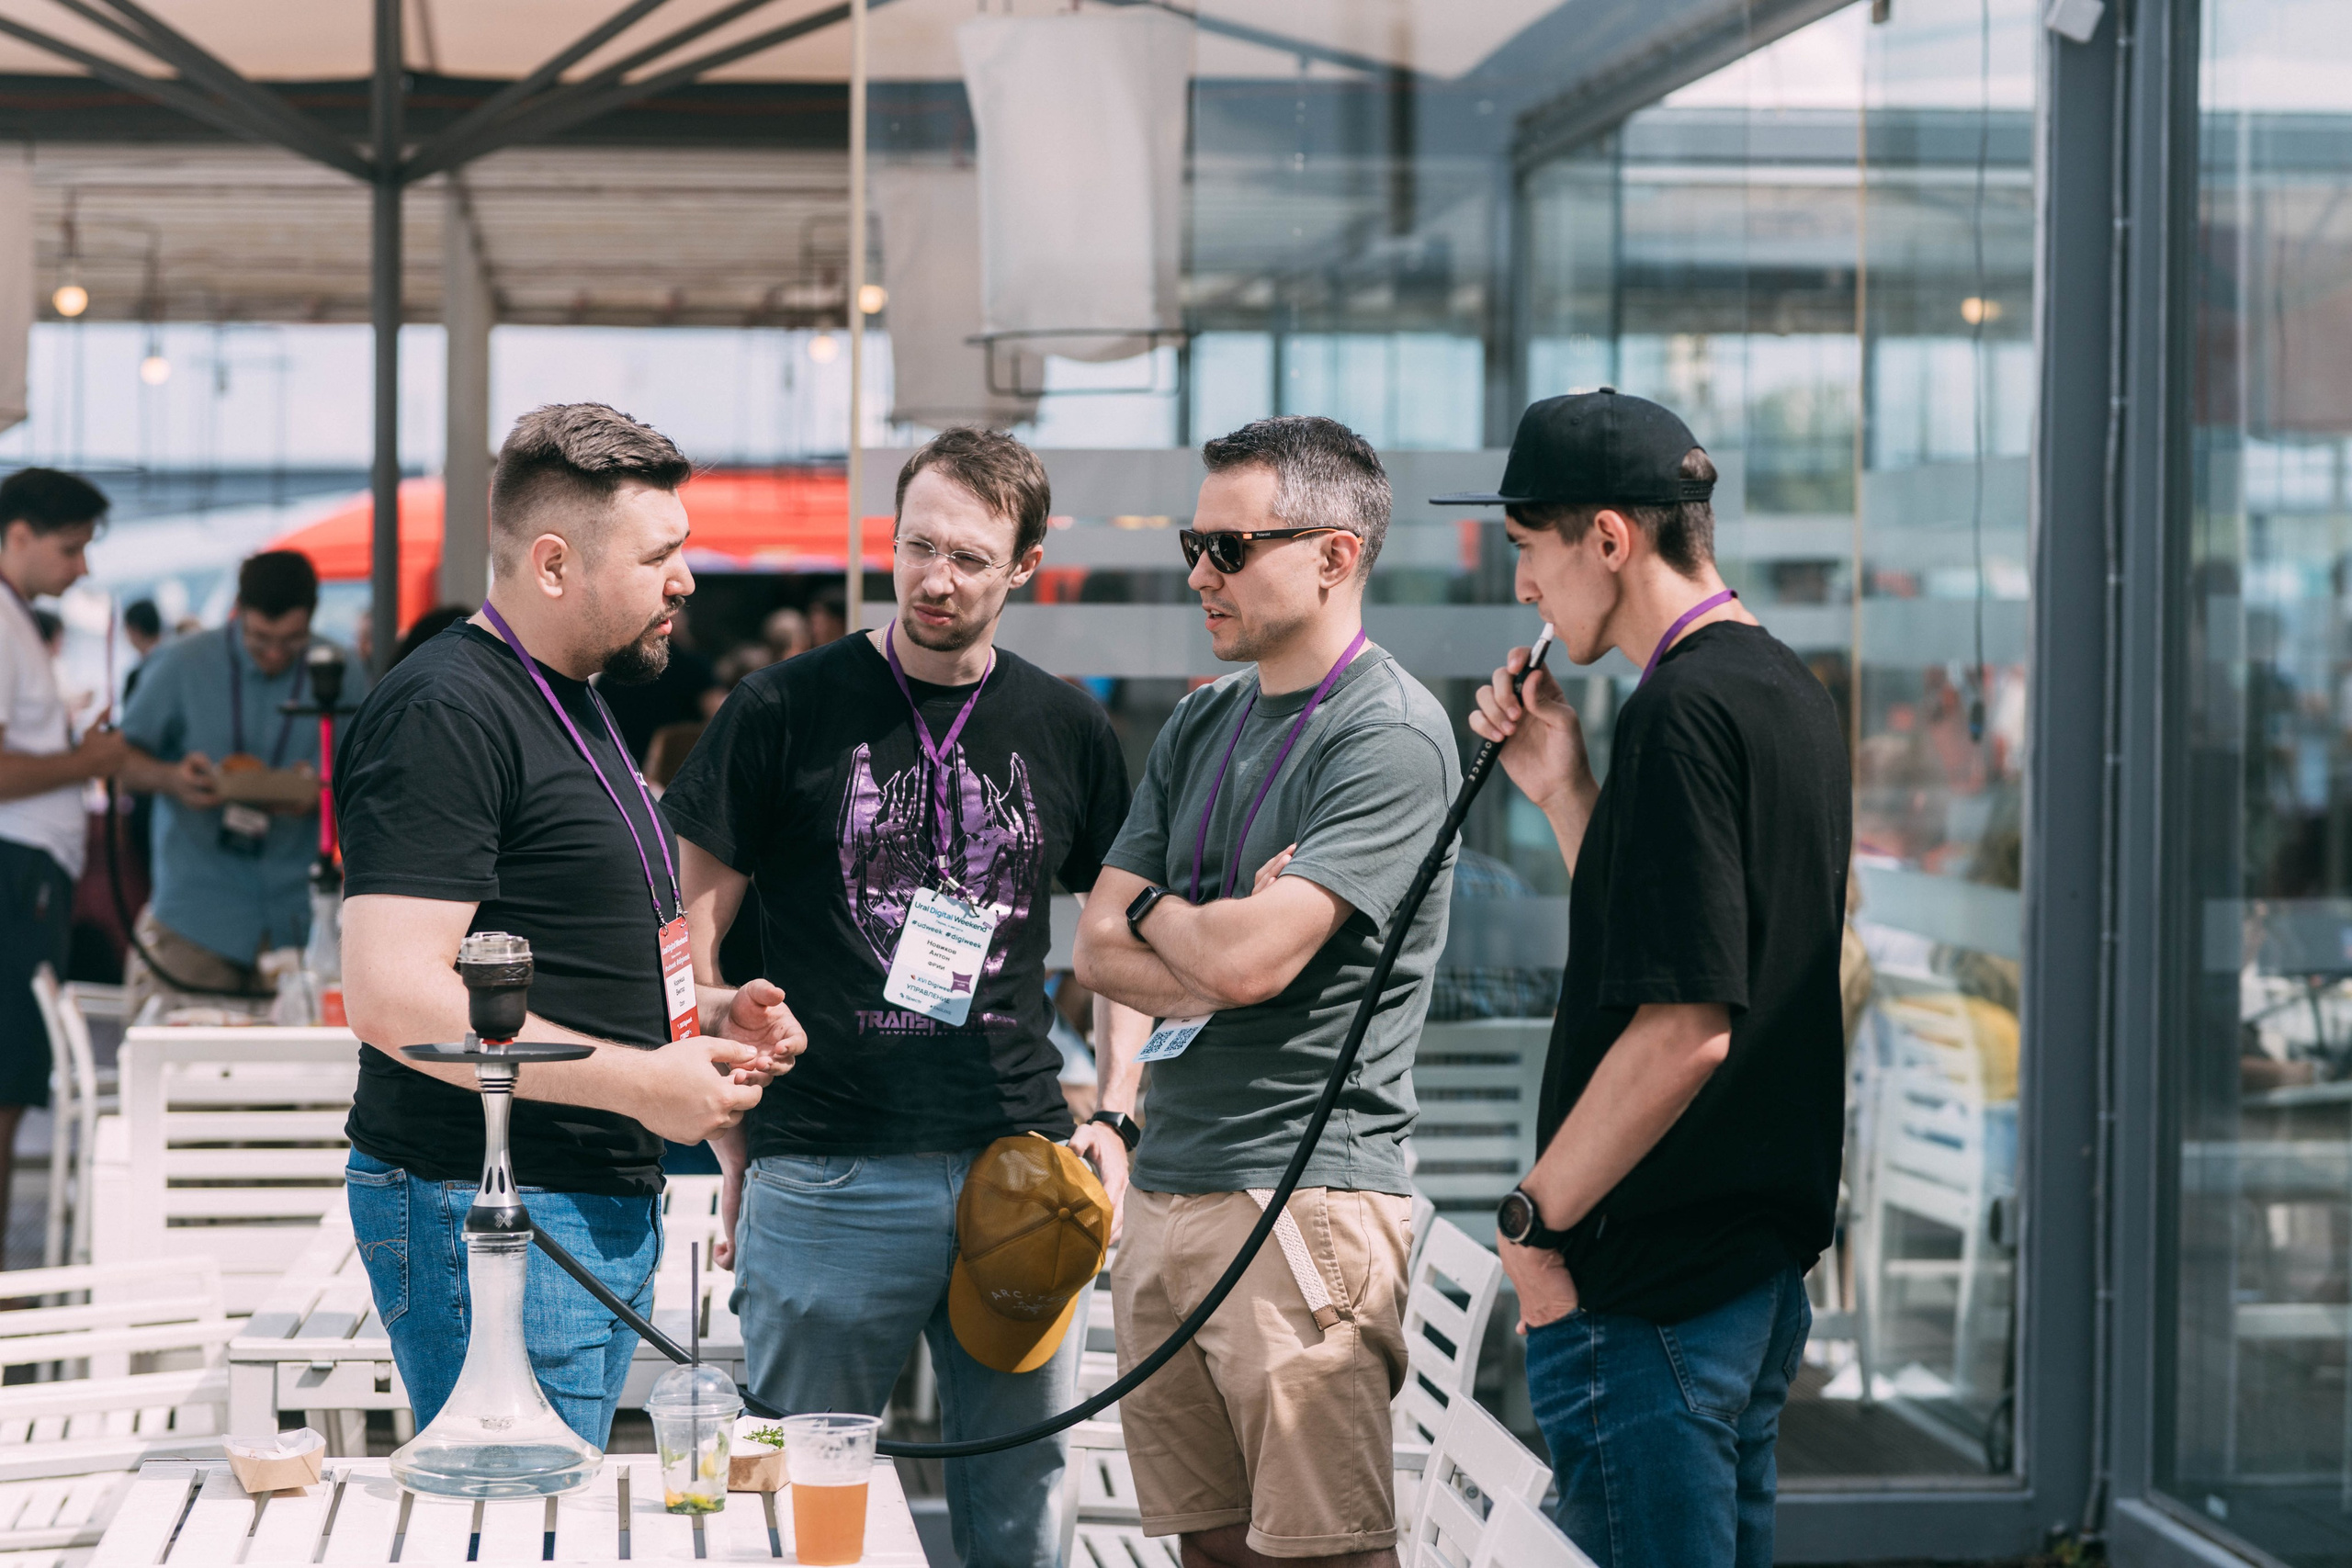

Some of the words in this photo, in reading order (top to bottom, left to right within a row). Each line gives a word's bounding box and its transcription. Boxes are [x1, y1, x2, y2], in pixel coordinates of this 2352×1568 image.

[914, 901, 930, 912] Ural
[929, 907, 954, 920] Digital
[954, 915, 988, 932] Weekend
[911, 919, 943, 935] #udweek
[944, 931, 982, 949] #digiweek
[926, 939, 957, 955] Новиков
[929, 949, 951, 962] Антон
[906, 983, 951, 1004] УПРАВЛЕНИЕ
[927, 980, 954, 993] Digiweek
